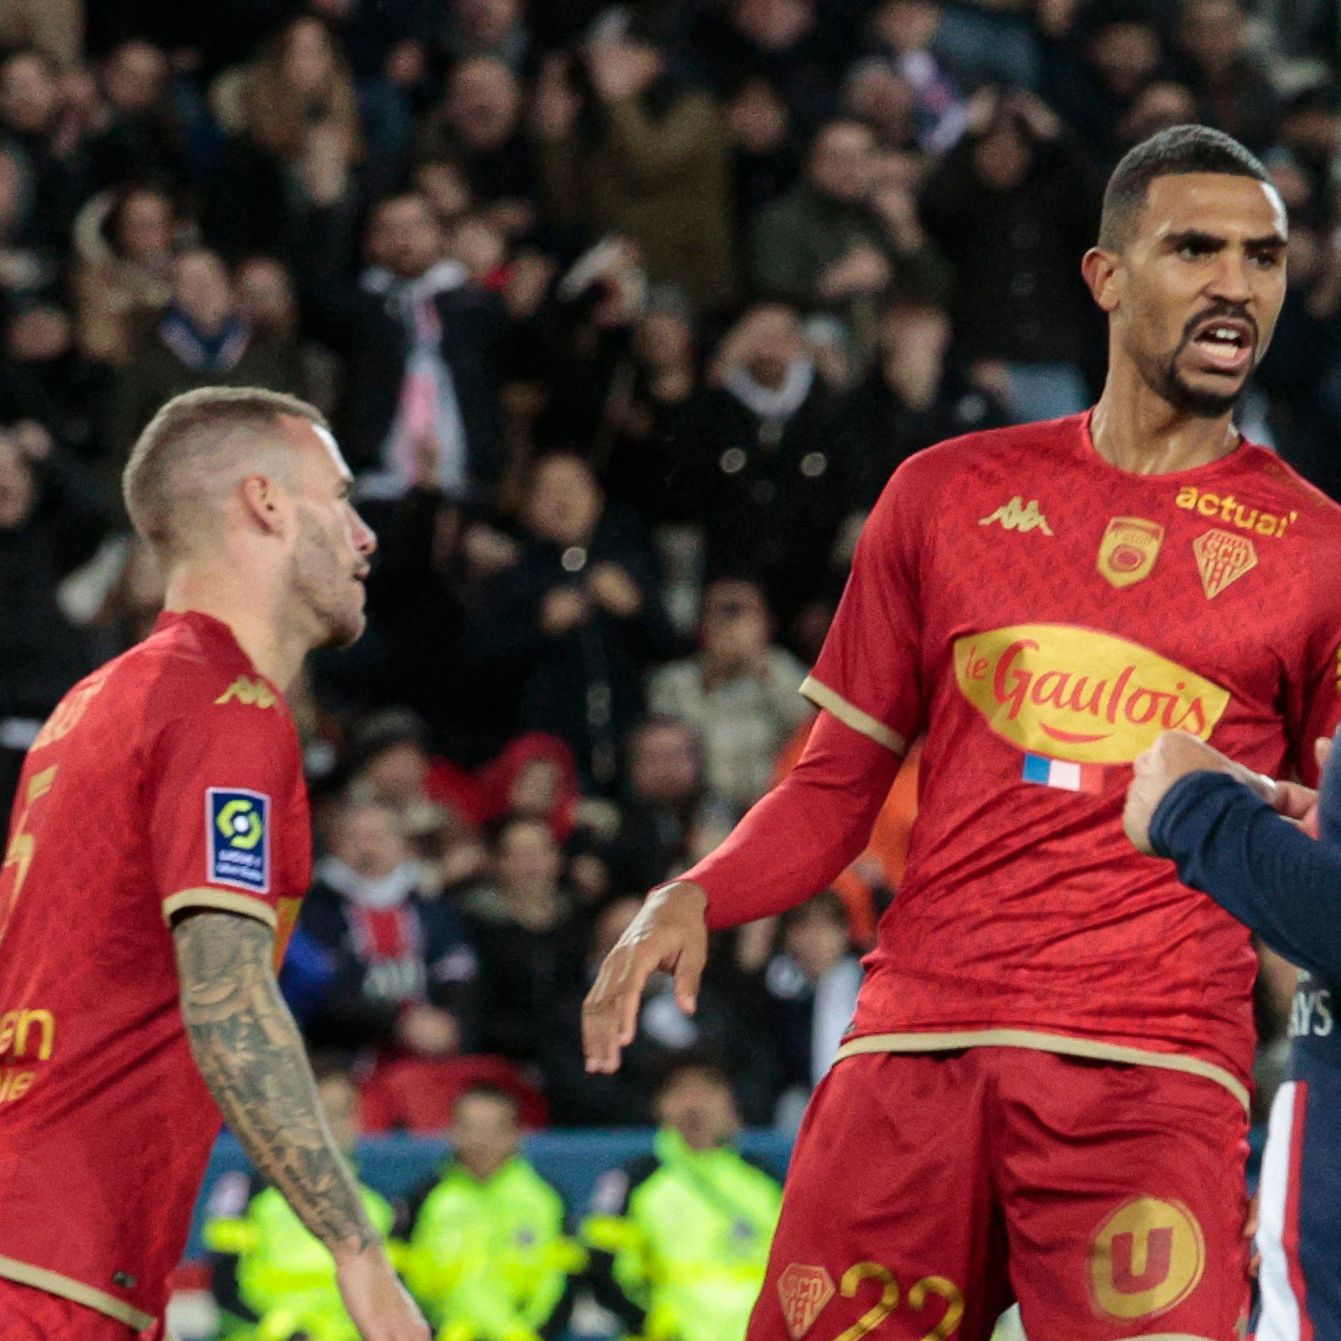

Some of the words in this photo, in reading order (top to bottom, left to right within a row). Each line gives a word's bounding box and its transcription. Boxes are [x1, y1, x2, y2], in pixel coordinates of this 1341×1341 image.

[964, 645, 989, 681] le
[993, 639, 1206, 735] Gaulois
[1111, 1226, 1174, 1294] U
